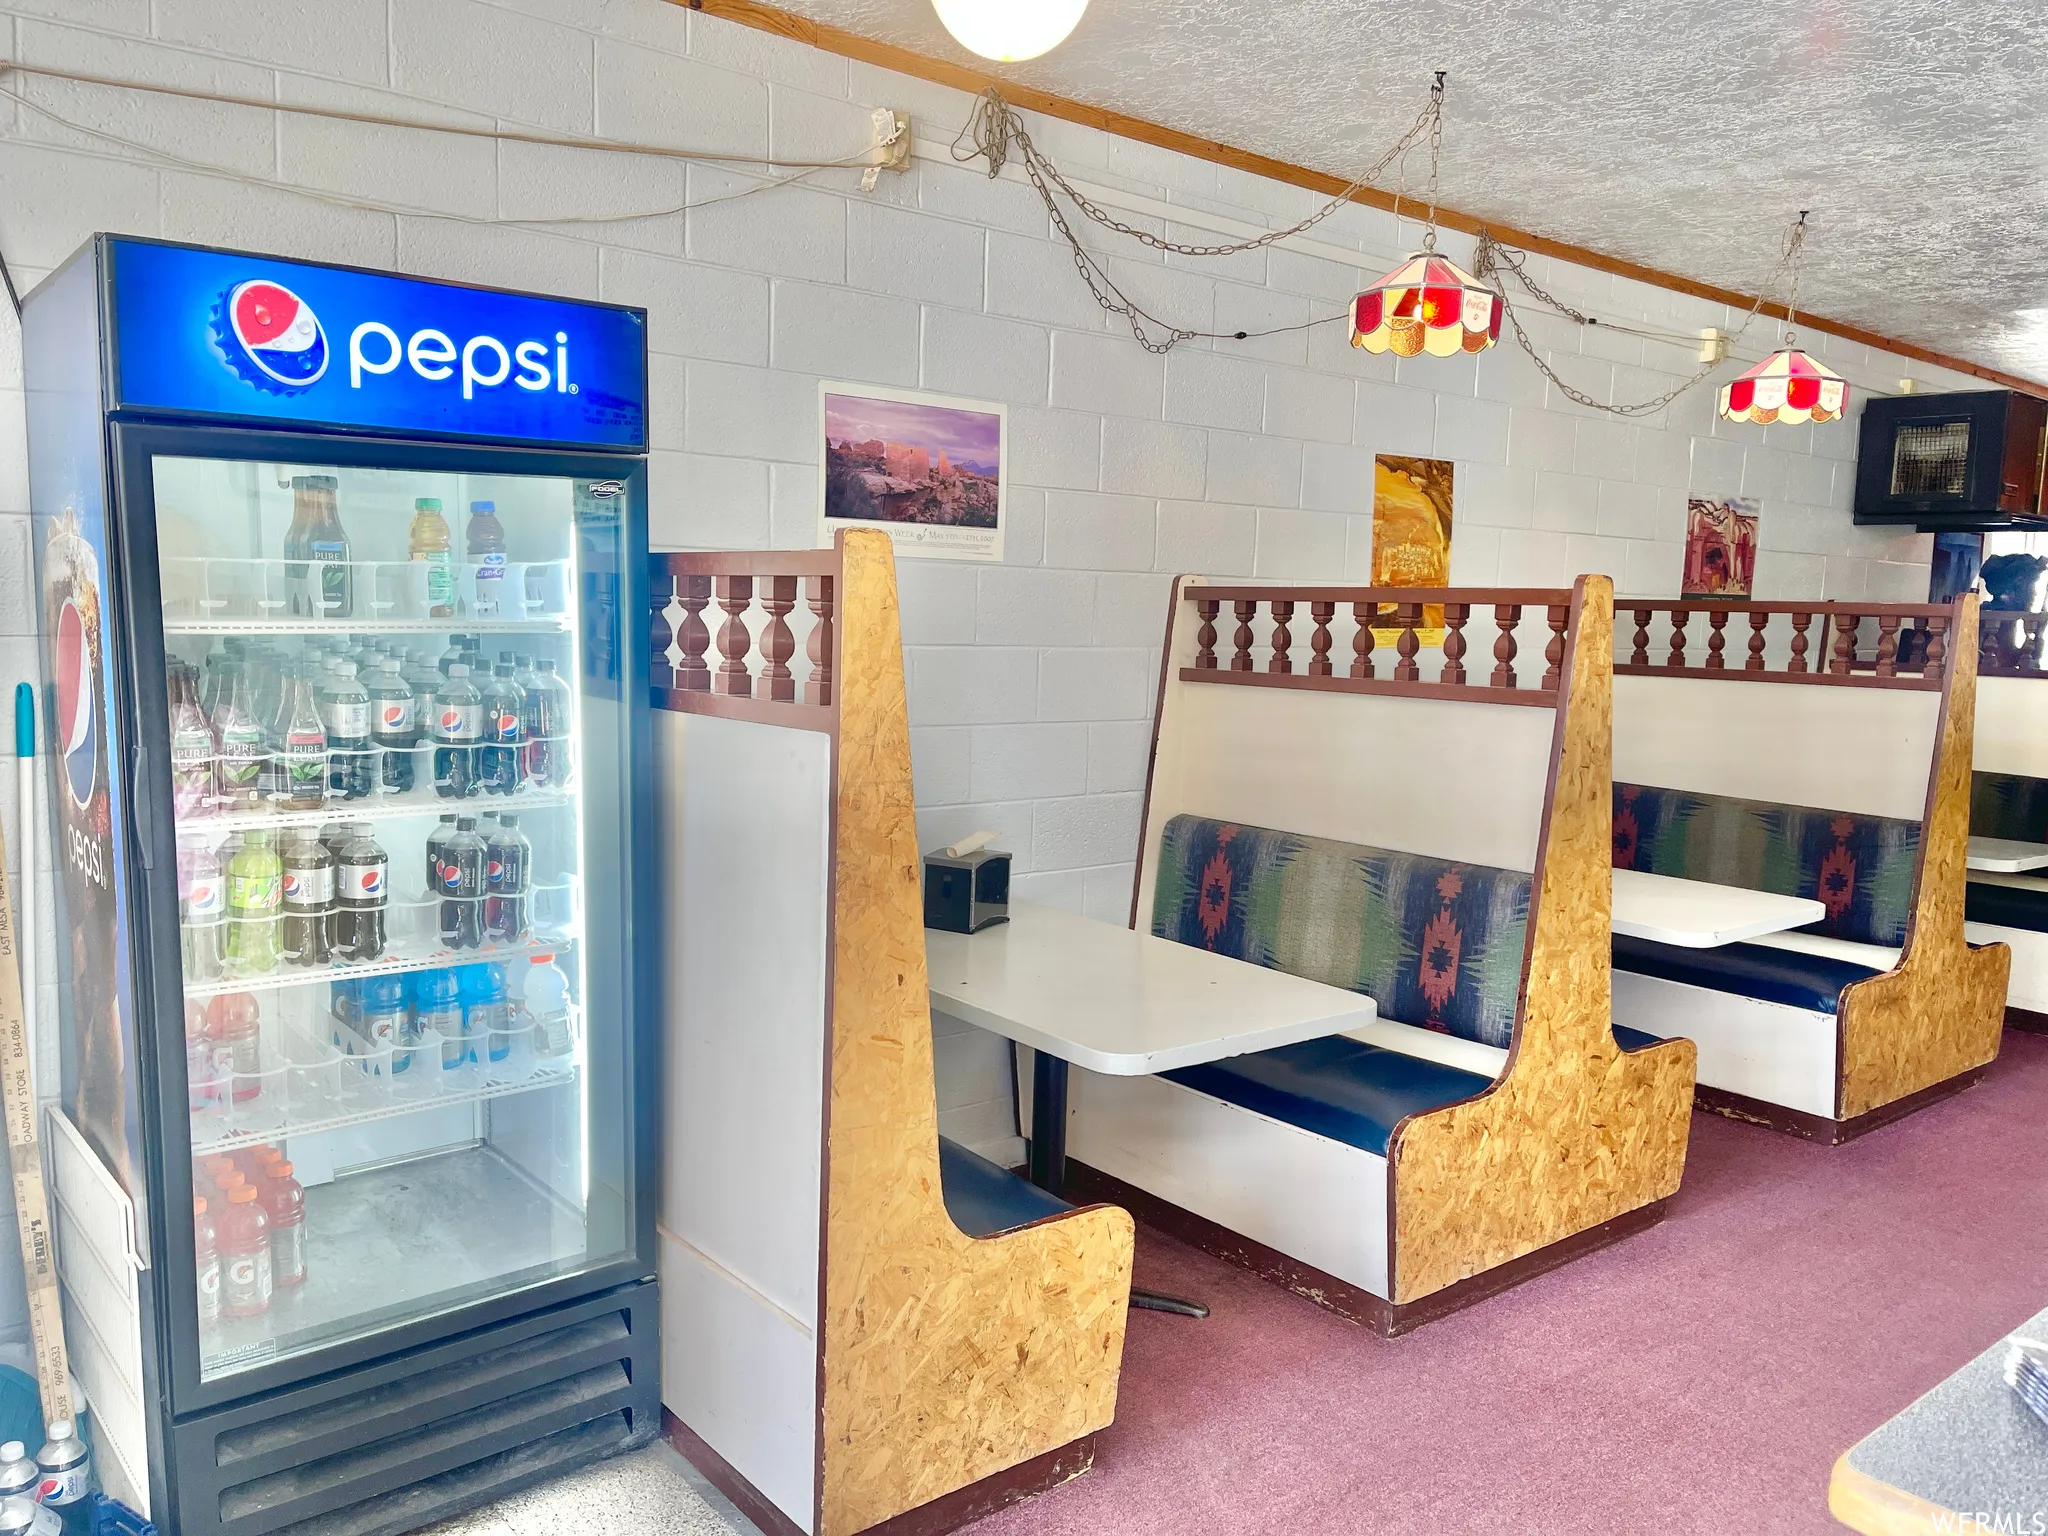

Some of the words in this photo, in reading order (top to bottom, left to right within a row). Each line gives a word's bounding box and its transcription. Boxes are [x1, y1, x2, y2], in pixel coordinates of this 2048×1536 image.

[349, 321, 568, 400] pepsi
[315, 551, 341, 561] PURE
[177, 748, 208, 759] PURE
[226, 744, 256, 753] PURE
[293, 745, 320, 754] PURE
[67, 823, 105, 887] pepsi
[0, 935, 11, 956] EAST
[10, 1019, 23, 1058] 834-0864
[16, 1069, 27, 1097] STORE
[230, 1259, 255, 1285] G
[218, 1343, 260, 1358] IMPORTANT
[67, 1476, 76, 1497] pepsi
